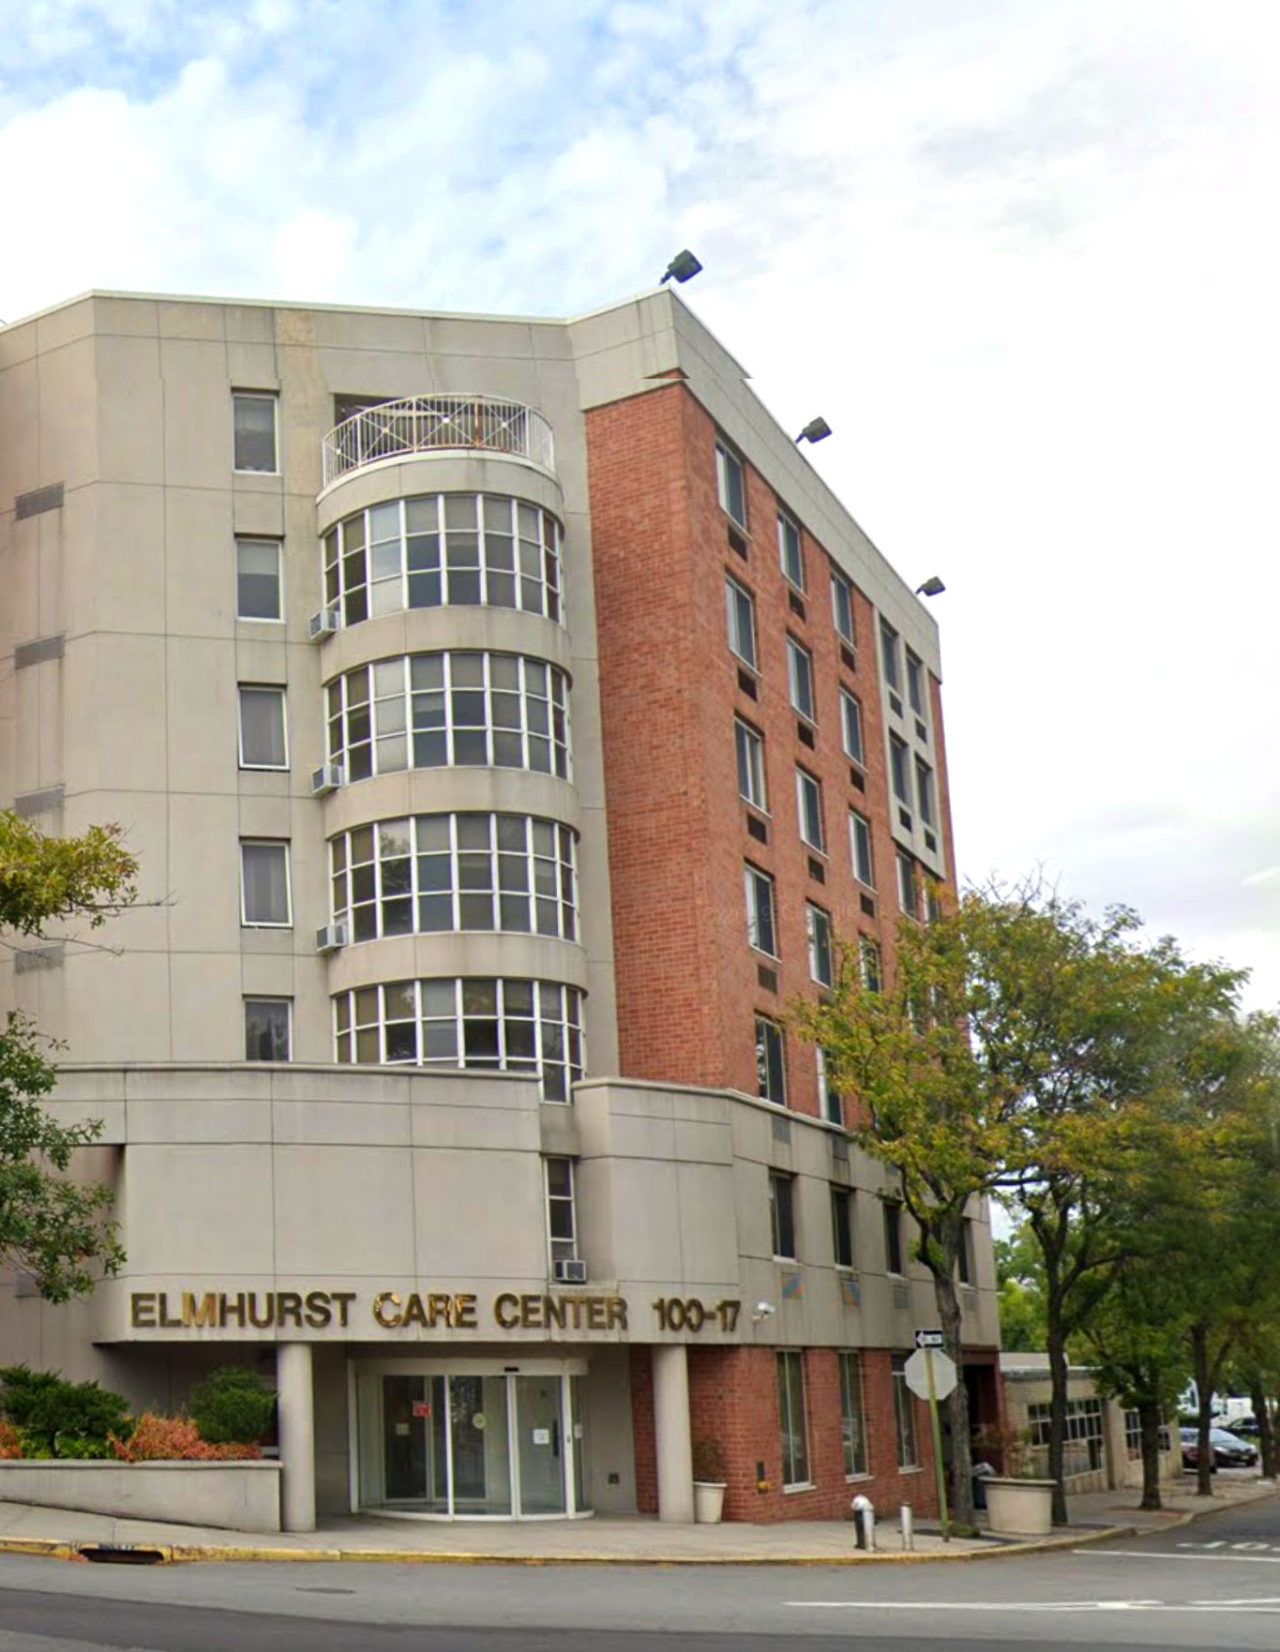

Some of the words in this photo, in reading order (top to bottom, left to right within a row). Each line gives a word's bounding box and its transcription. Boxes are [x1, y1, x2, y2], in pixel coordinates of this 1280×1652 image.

[131, 1291, 357, 1328] ELMHURST
[374, 1292, 478, 1329] CARE
[494, 1293, 628, 1330] CENTER
[652, 1298, 742, 1332] 100-17
